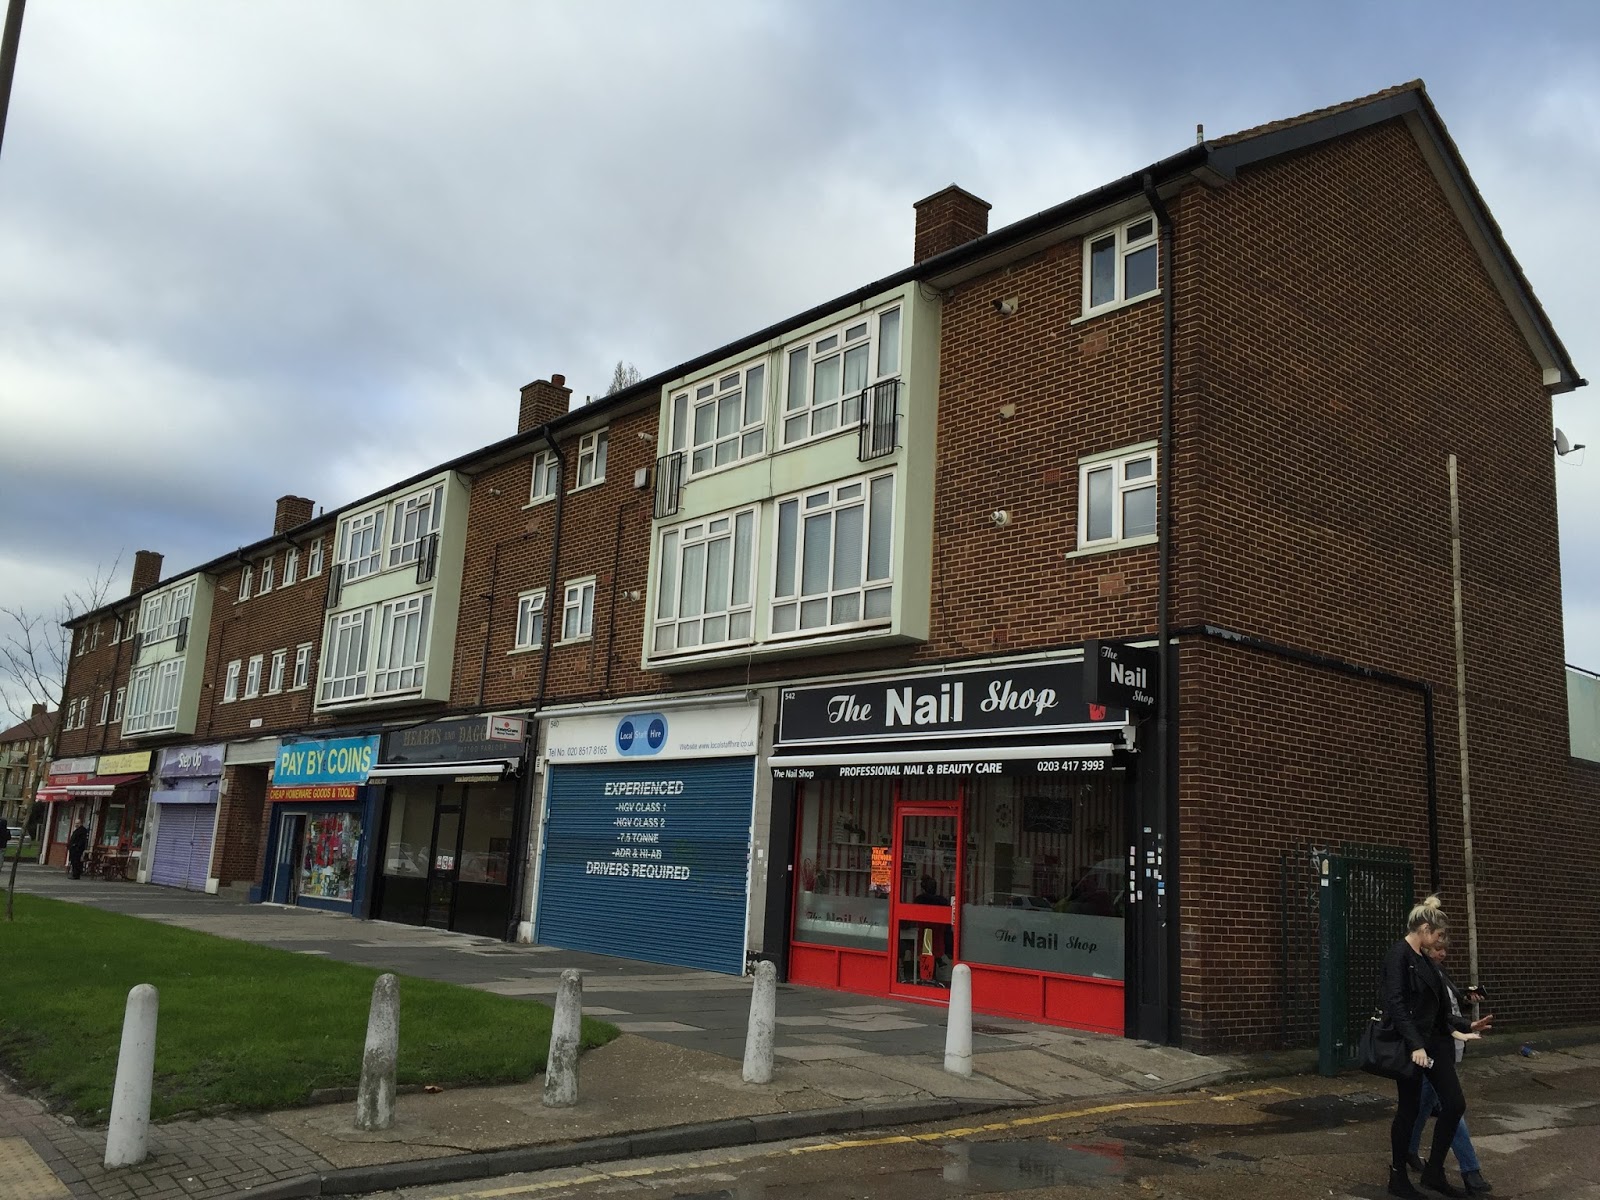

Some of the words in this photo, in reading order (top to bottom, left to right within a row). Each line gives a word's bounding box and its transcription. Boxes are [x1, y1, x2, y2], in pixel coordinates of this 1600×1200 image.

[1100, 645, 1118, 660] The
[1110, 662, 1147, 689] Nail
[785, 692, 795, 700] 542
[827, 694, 872, 724] The
[885, 682, 964, 727] Nail
[980, 679, 1059, 717] Shop
[1132, 690, 1155, 706] Shop
[550, 720, 560, 729] 540
[402, 728, 442, 747] HEARTS
[458, 724, 488, 743] DAGG
[620, 731, 633, 740] Local
[650, 729, 662, 738] Hire
[548, 748, 556, 757] Tel
[567, 747, 577, 756] 020
[578, 746, 593, 755] 8517
[593, 745, 608, 755] 8165
[178, 752, 192, 772] Step
[192, 751, 202, 771] Up
[280, 751, 305, 776] PAY
[306, 749, 326, 775] BY
[327, 745, 372, 775] COINS
[773, 769, 785, 778] The
[785, 769, 798, 778] Nail
[798, 769, 815, 780] Shop
[839, 765, 901, 777] PROFESSIONAL
[903, 764, 925, 775] NAIL
[926, 764, 934, 775] &
[936, 763, 973, 775] BEAUTY
[975, 762, 1003, 773] CARE
[1036, 761, 1060, 772] 0203
[1061, 760, 1079, 771] 417
[1081, 760, 1105, 771] 3993
[269, 790, 285, 800] CHEAP
[285, 789, 312, 799] HOMEWARE
[312, 788, 332, 799] GOODS
[331, 788, 336, 798] &
[337, 787, 356, 798] TOOLS
[604, 780, 685, 796] EXPERIENCED
[634, 802, 661, 812] CLASS
[633, 817, 659, 828] CLASS
[660, 818, 666, 828] 2
[631, 833, 660, 844] TONNE
[631, 848, 639, 858] &
[585, 861, 630, 877] DRIVERS
[631, 863, 691, 881] REQUIRED
[826, 912, 852, 929] Nail
[994, 929, 1017, 943] The
[1022, 930, 1058, 951] Nail
[1065, 935, 1098, 954] Shop
